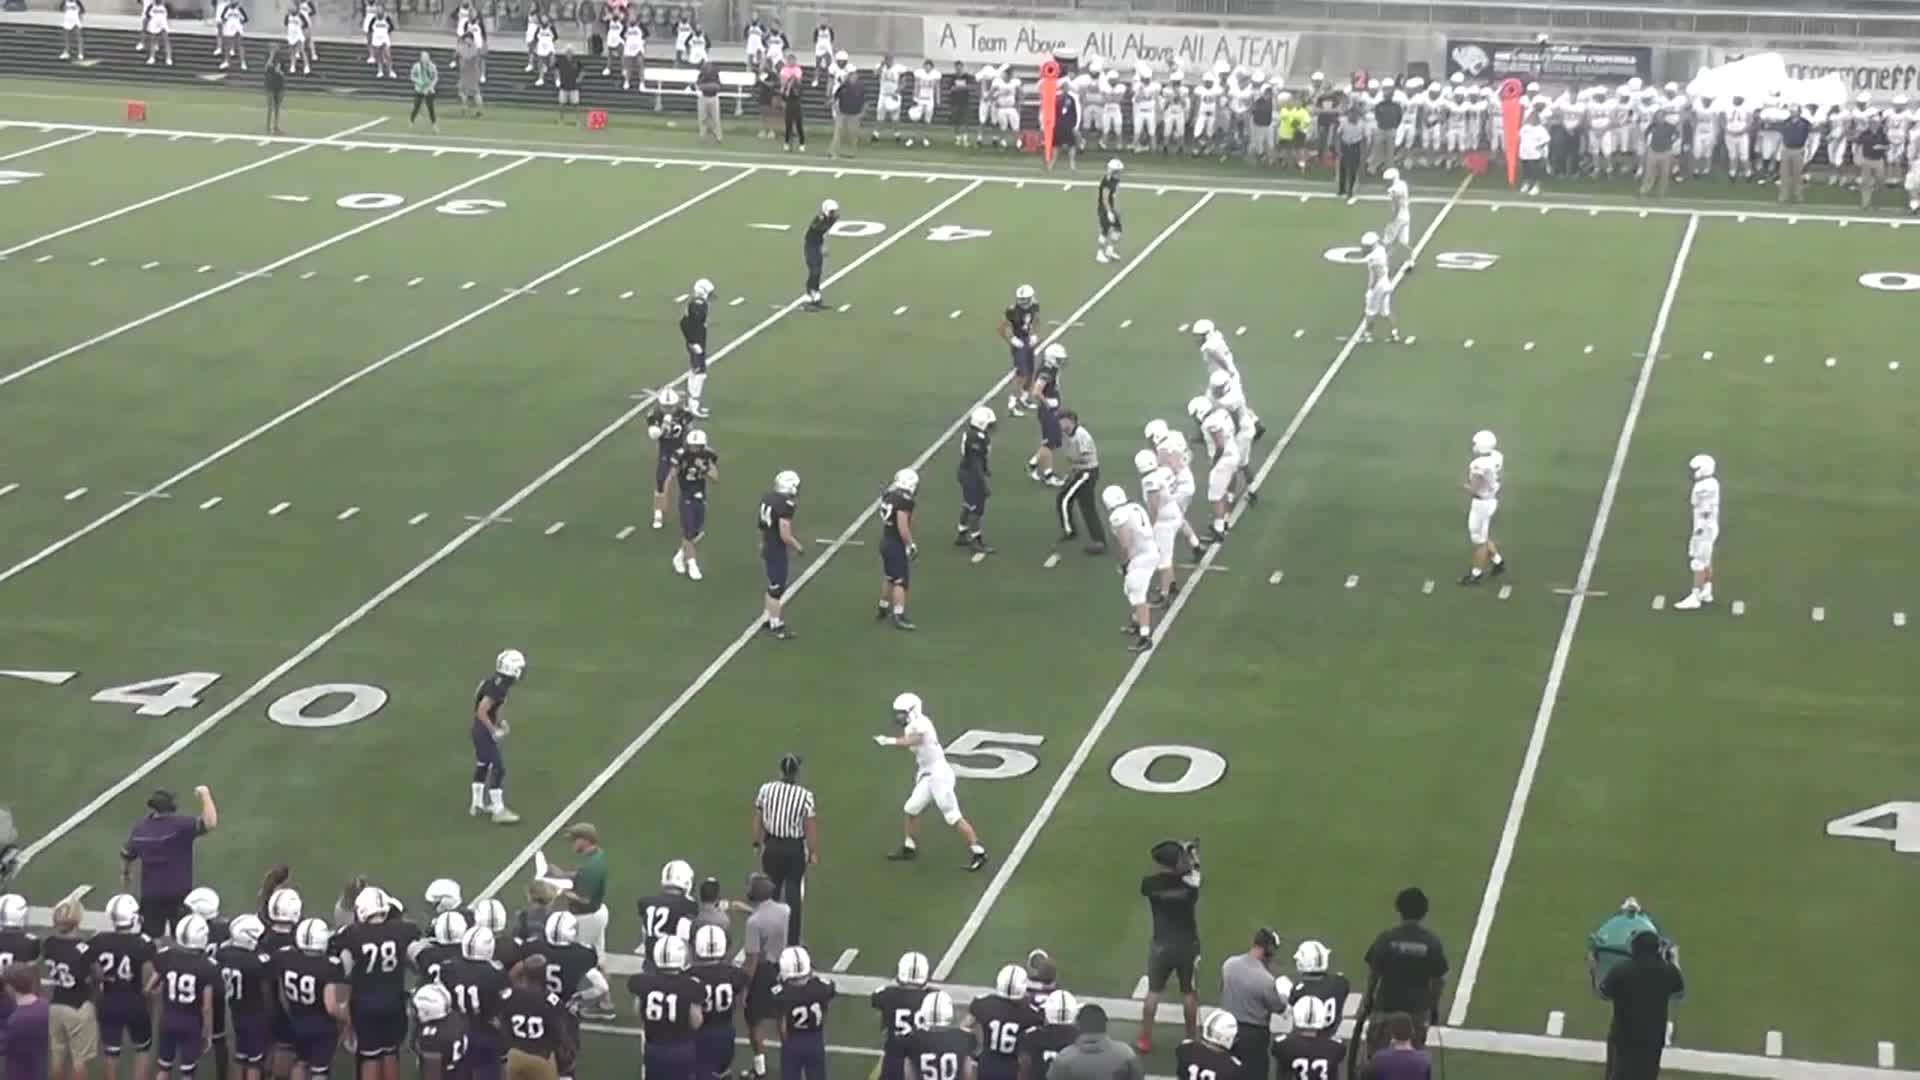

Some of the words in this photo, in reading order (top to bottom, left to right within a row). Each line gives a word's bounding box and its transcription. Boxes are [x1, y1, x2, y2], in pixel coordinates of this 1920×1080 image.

[939, 23, 957, 48] A
[967, 23, 1007, 52] Team
[1014, 26, 1066, 53] Above
[1212, 35, 1235, 66] A
[1239, 35, 1290, 68] TEAM
[646, 905, 670, 937] 12
[99, 951, 133, 981] 24
[361, 940, 398, 974] 78
[166, 970, 196, 1004] 19
[284, 969, 316, 1005] 59
[454, 983, 480, 1014] 11
[646, 990, 677, 1022] 61
[791, 1001, 822, 1029] 21
[511, 1013, 545, 1039] 20
[989, 1019, 1019, 1054] 16
[920, 1052, 958, 1080] 50
